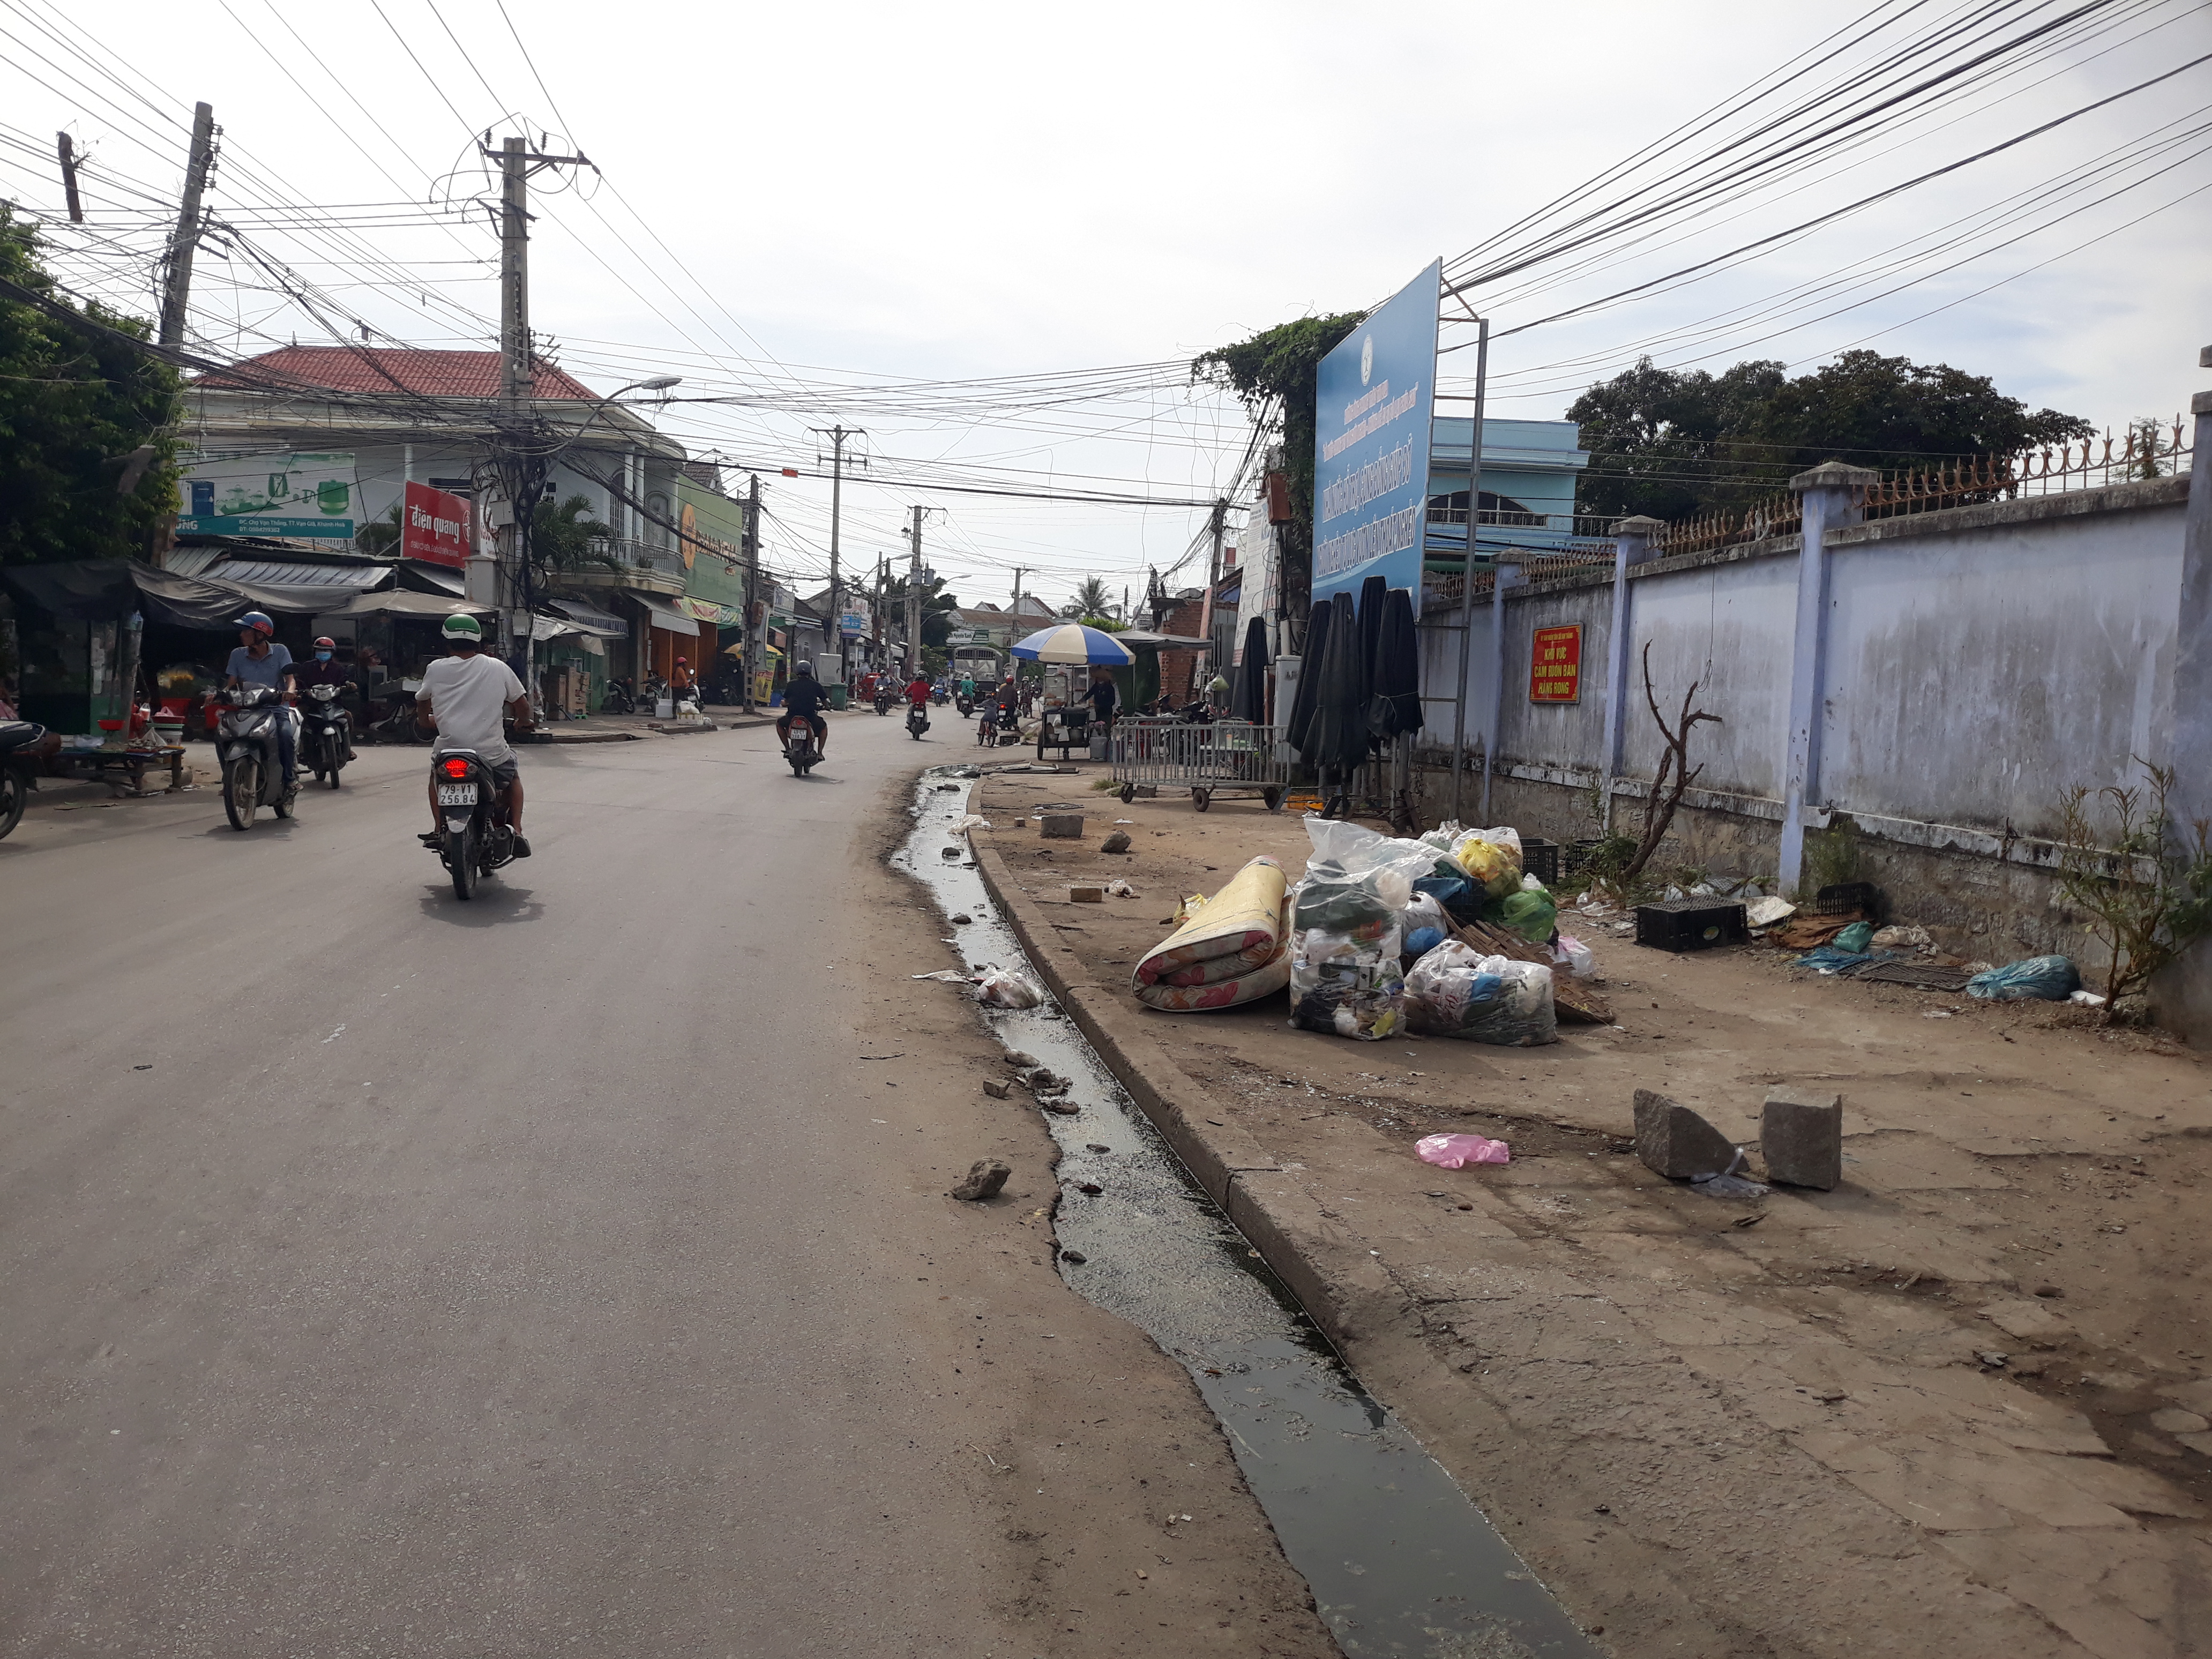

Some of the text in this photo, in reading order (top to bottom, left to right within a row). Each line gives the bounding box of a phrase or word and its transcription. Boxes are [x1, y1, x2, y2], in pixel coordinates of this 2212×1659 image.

[409, 504, 432, 532] điện
[433, 517, 460, 544] quang
[1544, 645, 1567, 662] KHU VỰC
[1563, 661, 1576, 677] BÁN
[1553, 681, 1570, 694] RONG
[445, 785, 470, 794] 79-V1
[441, 794, 475, 804] 256.84
